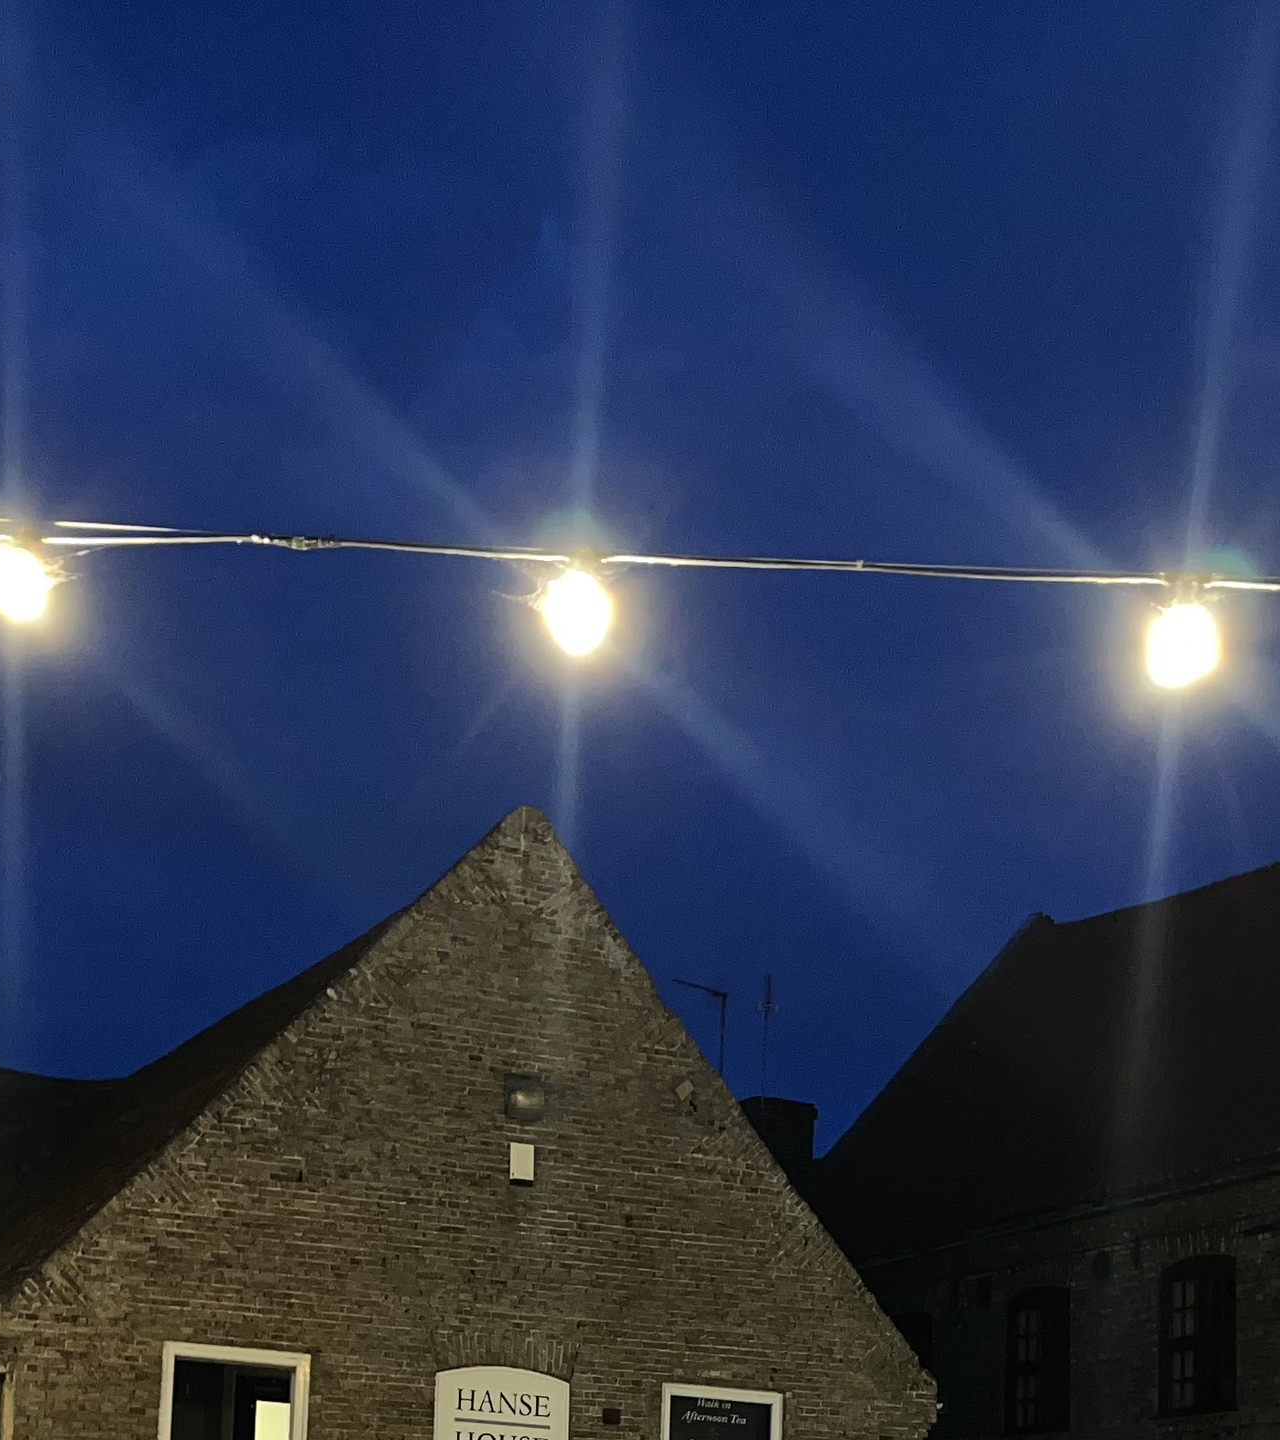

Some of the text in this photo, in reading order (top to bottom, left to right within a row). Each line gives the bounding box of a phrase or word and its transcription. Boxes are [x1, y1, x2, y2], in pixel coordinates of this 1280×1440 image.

[455, 1387, 552, 1418] HANSE
[697, 1398, 720, 1409] Walk
[681, 1410, 747, 1425] Afternoon Tea
